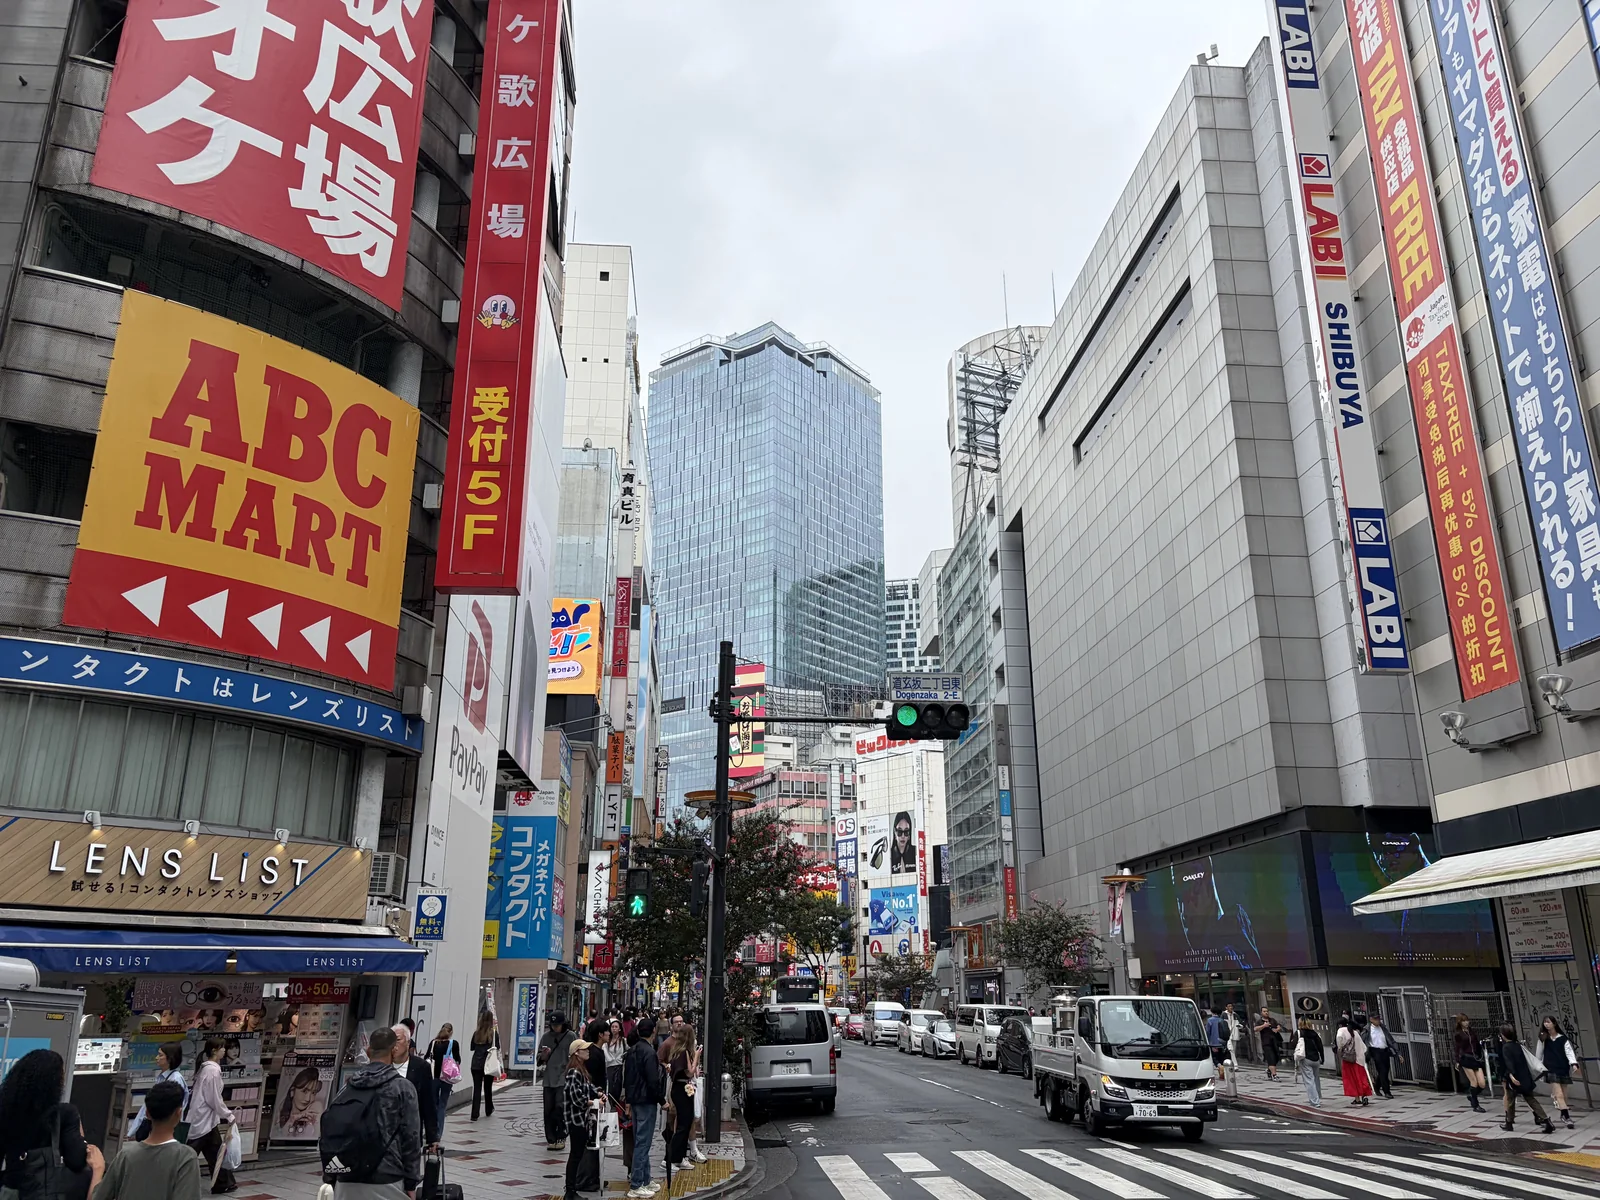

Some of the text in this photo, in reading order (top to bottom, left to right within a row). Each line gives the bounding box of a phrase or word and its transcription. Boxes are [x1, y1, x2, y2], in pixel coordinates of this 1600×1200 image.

[1279, 6, 1316, 82] LABI
[1368, 40, 1403, 140] TAX
[486, 14, 539, 238] ケ歌広場
[1379, 133, 1400, 198] 供应店
[1392, 117, 1415, 183] 免税品
[1303, 184, 1347, 281] LABI
[1390, 178, 1434, 303] FREE
[1325, 302, 1364, 430] SHIBUYA
[1434, 341, 1466, 457] TAXFREE
[148, 338, 392, 509] ABC
[133, 450, 381, 588] MART
[1461, 488, 1479, 529] 5%
[1358, 557, 1405, 658] LABI
[1469, 536, 1508, 673] DISCOUNT
[613, 657, 627, 674] 千
[1460, 613, 1486, 686] 的折扣
[20, 649, 413, 741] ンタクトはレンズリスト
[892, 676, 961, 690] 道玄坂二丁目東
[895, 691, 938, 700] Dogenzaka
[450, 723, 489, 804] PayPay
[610, 736, 621, 779] 駄菓子バー
[856, 735, 919, 755] ビックカ
[837, 818, 855, 834] OS
[49, 840, 183, 880] LENS
[1182, 872, 1205, 881] OAKLEY
[71, 879, 283, 902] 試せる！コンタクトレンズショップ
[505, 826, 534, 947] コンタクト
[532, 839, 551, 932] メガネスーパー
[882, 890, 895, 898] Visa
[415, 926, 443, 935] 試せる！
[420, 917, 442, 926] 無料で
[75, 955, 114, 966] LENS
[306, 957, 336, 967] LENS
[137, 980, 175, 994] 無料で
[334, 986, 349, 996] OFF
[528, 986, 537, 1030] コンタクト
[1143, 1063, 1176, 1071] 高圧ガス
[325, 1166, 352, 1174] adidas
